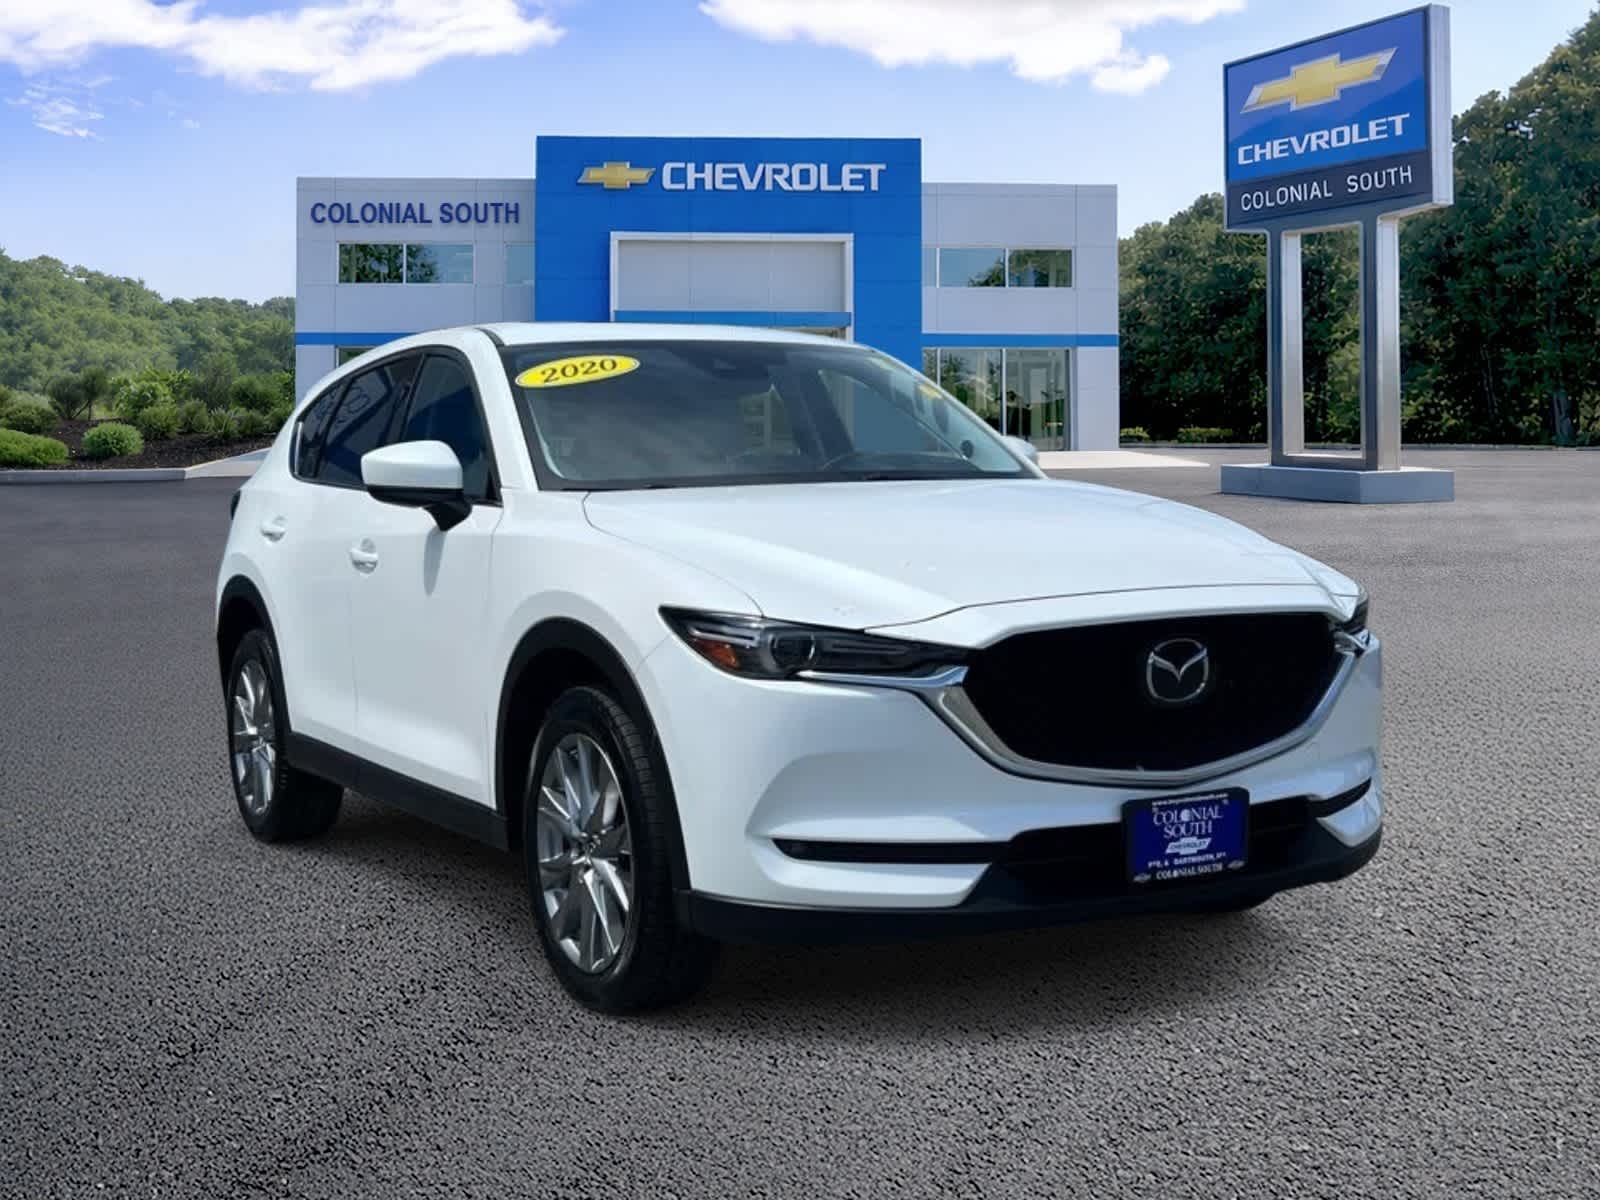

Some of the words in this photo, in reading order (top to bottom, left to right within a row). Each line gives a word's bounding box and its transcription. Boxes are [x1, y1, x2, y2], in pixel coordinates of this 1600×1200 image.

[1237, 113, 1410, 165] CHEVROLET
[662, 162, 887, 191] CHEVROLET
[1240, 180, 1333, 211] COLONIAL
[1346, 165, 1413, 194] SOUTH
[310, 202, 433, 224] COLONIAL
[439, 202, 520, 224] SOUTH
[540, 359, 617, 383] 2020
[1152, 805, 1223, 826] COLONIAL
[1163, 820, 1213, 840] SOUTH
